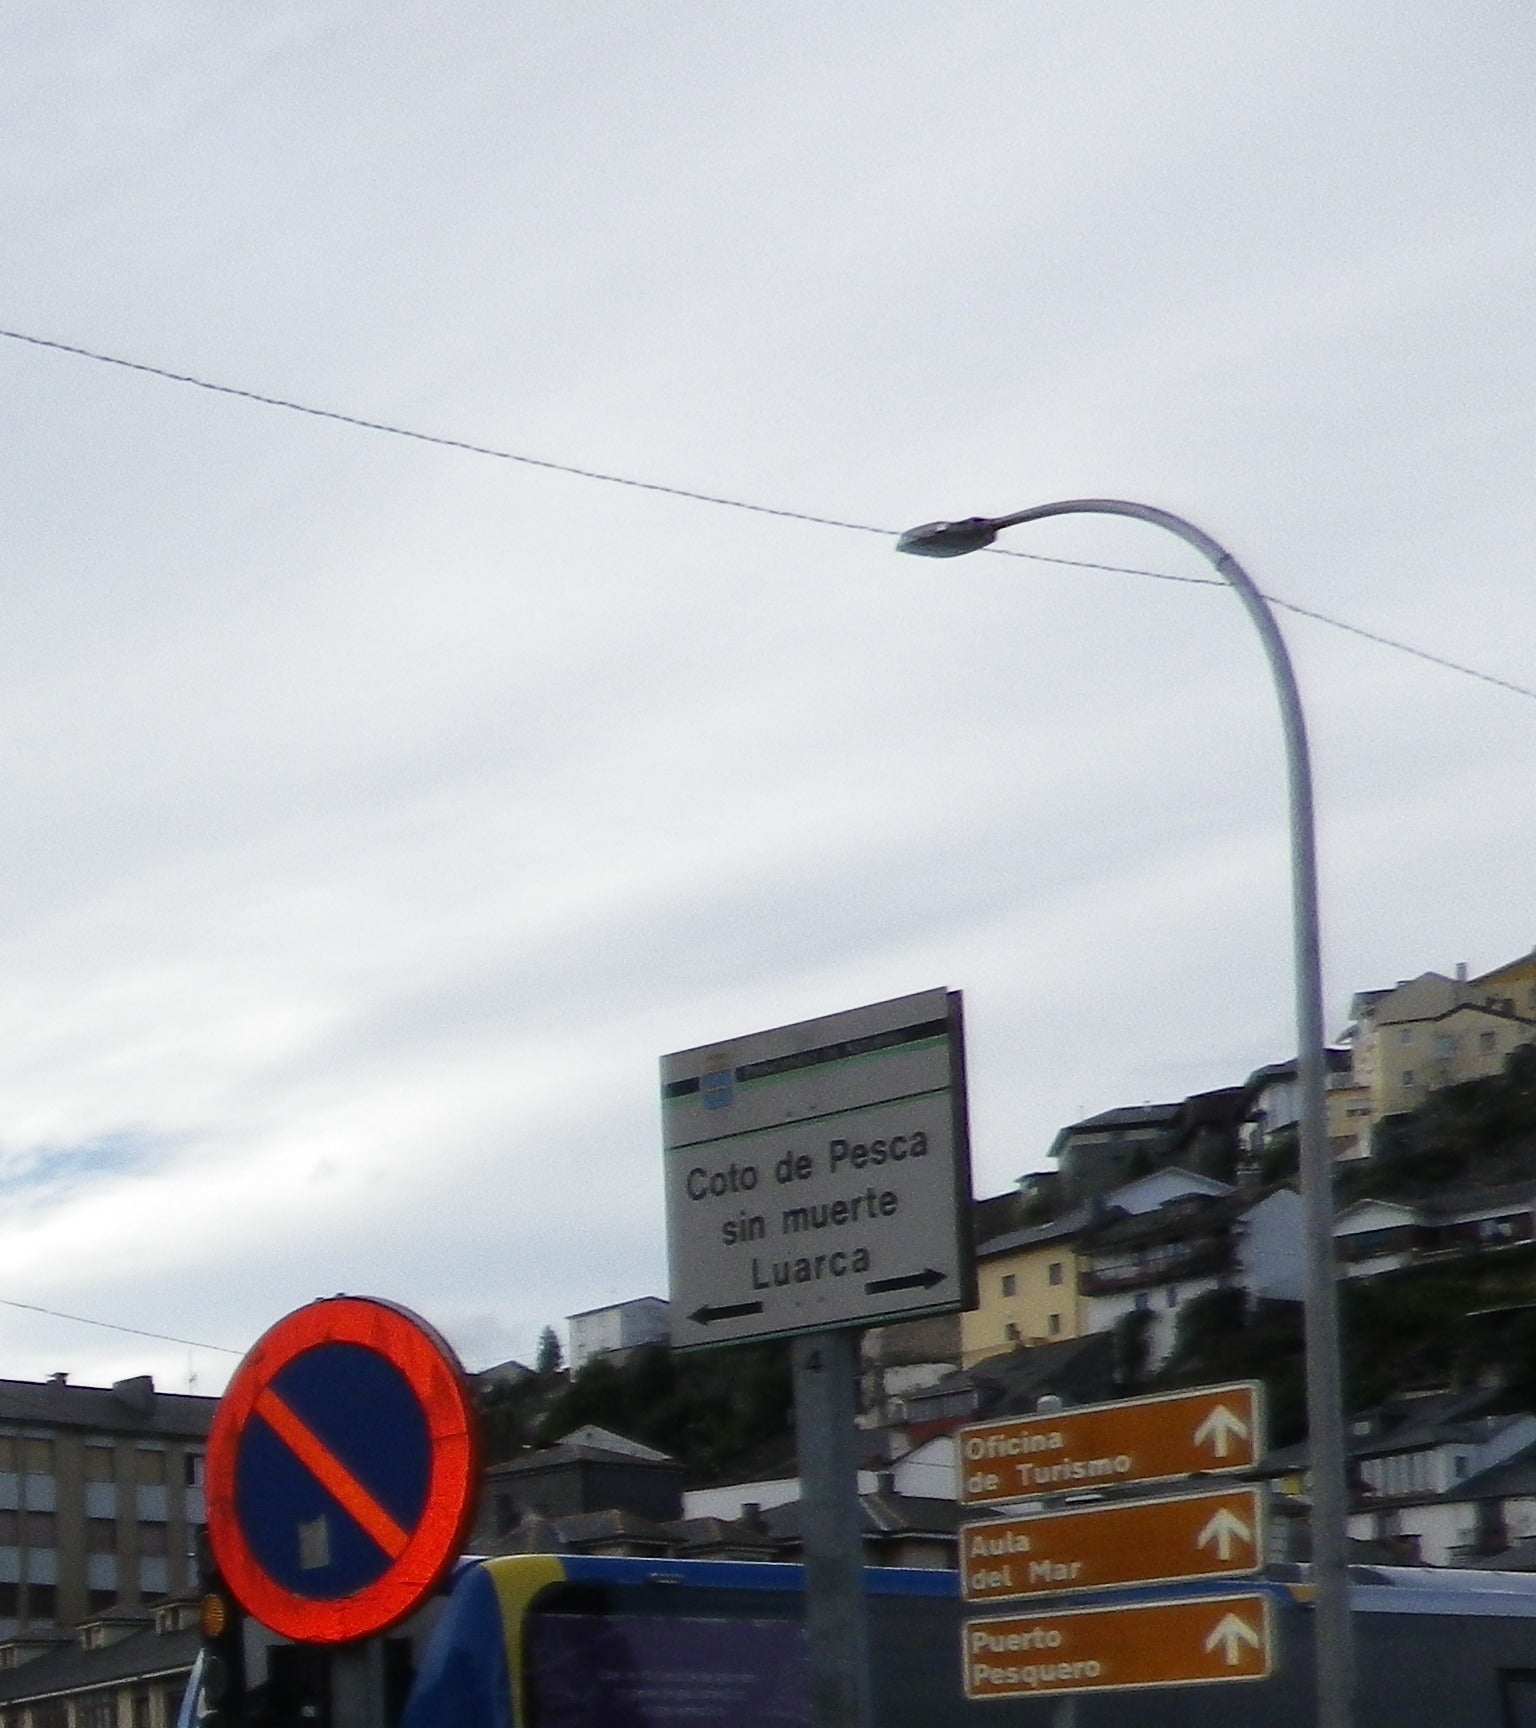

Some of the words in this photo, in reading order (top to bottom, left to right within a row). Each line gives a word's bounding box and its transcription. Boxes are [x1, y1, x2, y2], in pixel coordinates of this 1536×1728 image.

[686, 1164, 758, 1201] Coto
[775, 1150, 813, 1185] de
[829, 1130, 929, 1174] Pesca
[721, 1210, 766, 1246] sin
[782, 1187, 899, 1235] muerte
[751, 1247, 871, 1290] Luarca
[965, 1429, 1065, 1461] Oficina
[968, 1471, 1000, 1494] de
[1016, 1453, 1134, 1487] Turismo
[970, 1531, 1032, 1558] Aula
[970, 1564, 1014, 1591] del
[1028, 1559, 1082, 1585] Mar
[970, 1626, 1064, 1655] Puerto
[971, 1657, 1103, 1688] Pesquero
